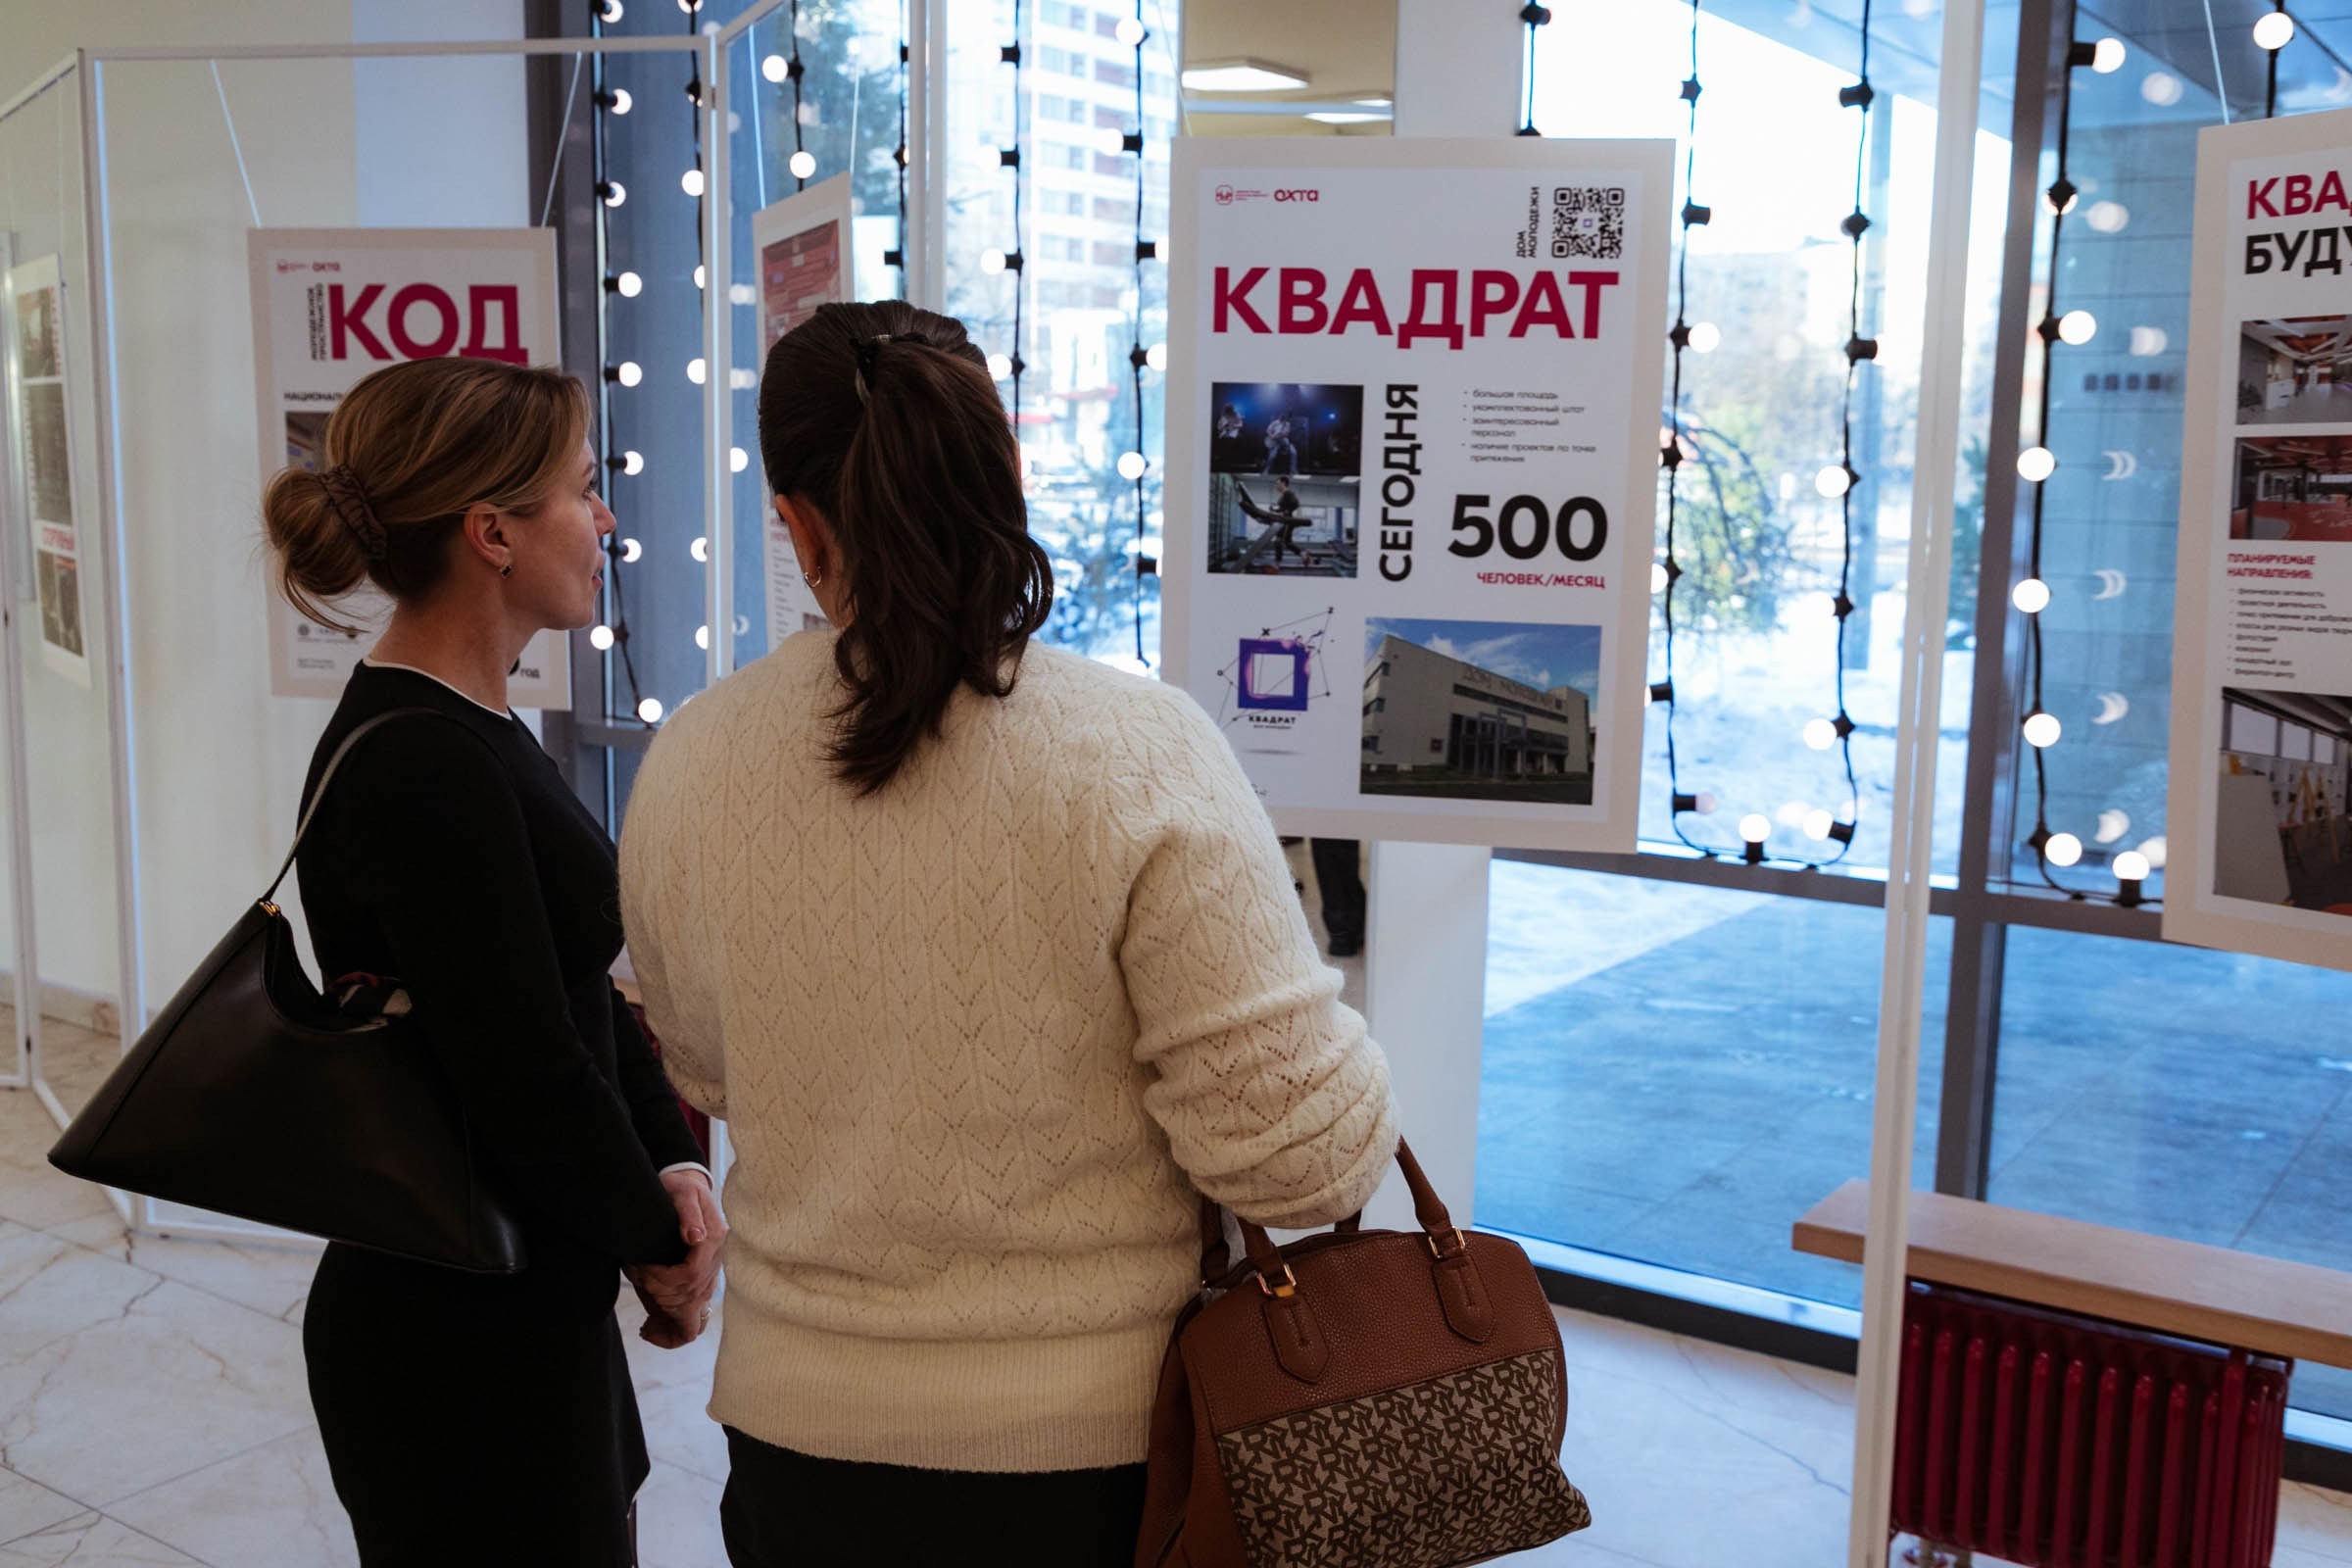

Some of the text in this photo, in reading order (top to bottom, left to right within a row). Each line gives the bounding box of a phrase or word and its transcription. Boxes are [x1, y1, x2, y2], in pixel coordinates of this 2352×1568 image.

[1528, 186, 1540, 258] МОЛОДЕЖИ
[2247, 170, 2352, 220] КВА
[1517, 230, 1526, 258] ДОМ
[328, 283, 527, 367] КОД
[1212, 267, 1619, 350] КВАДРАТ
[1473, 389, 1514, 398] большая
[1379, 383, 1424, 582] СЕГОДНЯ
[1448, 494, 1607, 563] 500
[1477, 572, 1606, 590] ЧЕЛОВЕК/МЕСЯЦ
[1249, 715, 1297, 725] КВАДРАТ
